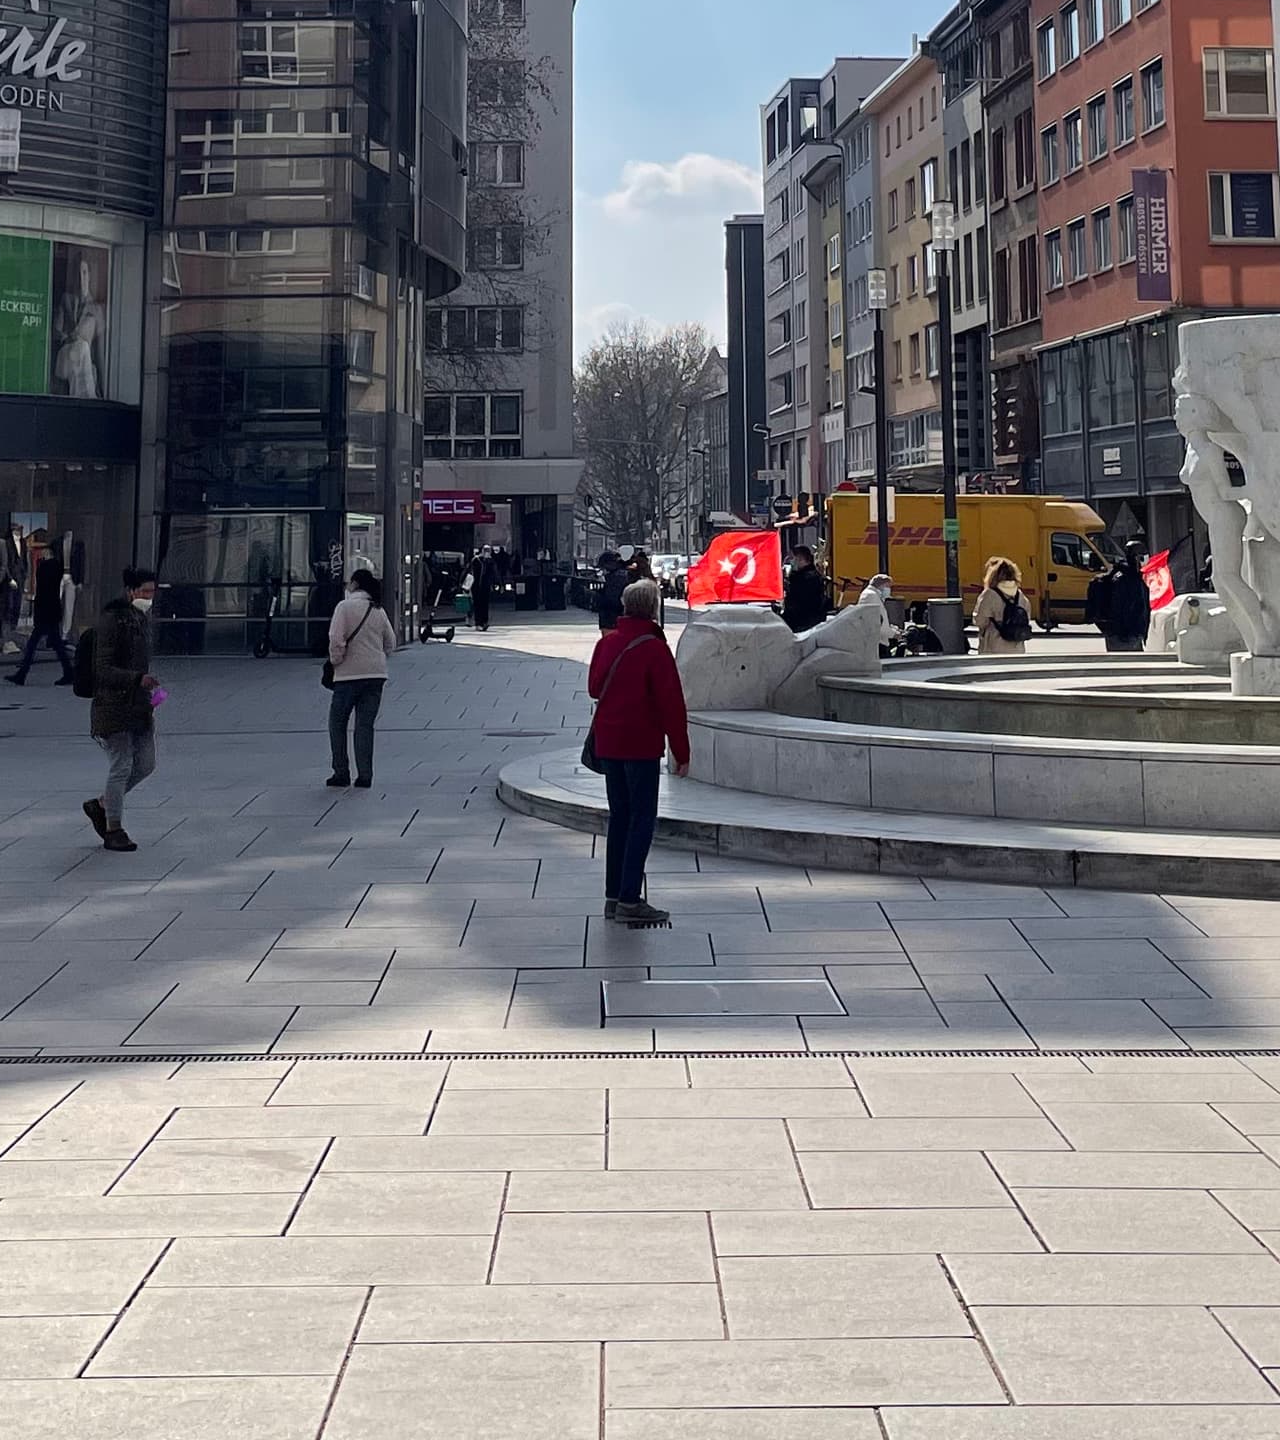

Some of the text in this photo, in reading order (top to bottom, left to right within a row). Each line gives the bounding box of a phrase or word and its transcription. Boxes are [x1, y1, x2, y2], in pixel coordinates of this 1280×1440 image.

[1135, 197, 1146, 232] GROSSE
[1150, 196, 1168, 274] HIRMER
[0, 299, 43, 315] ECKERLE
[863, 525, 947, 546] DHL
